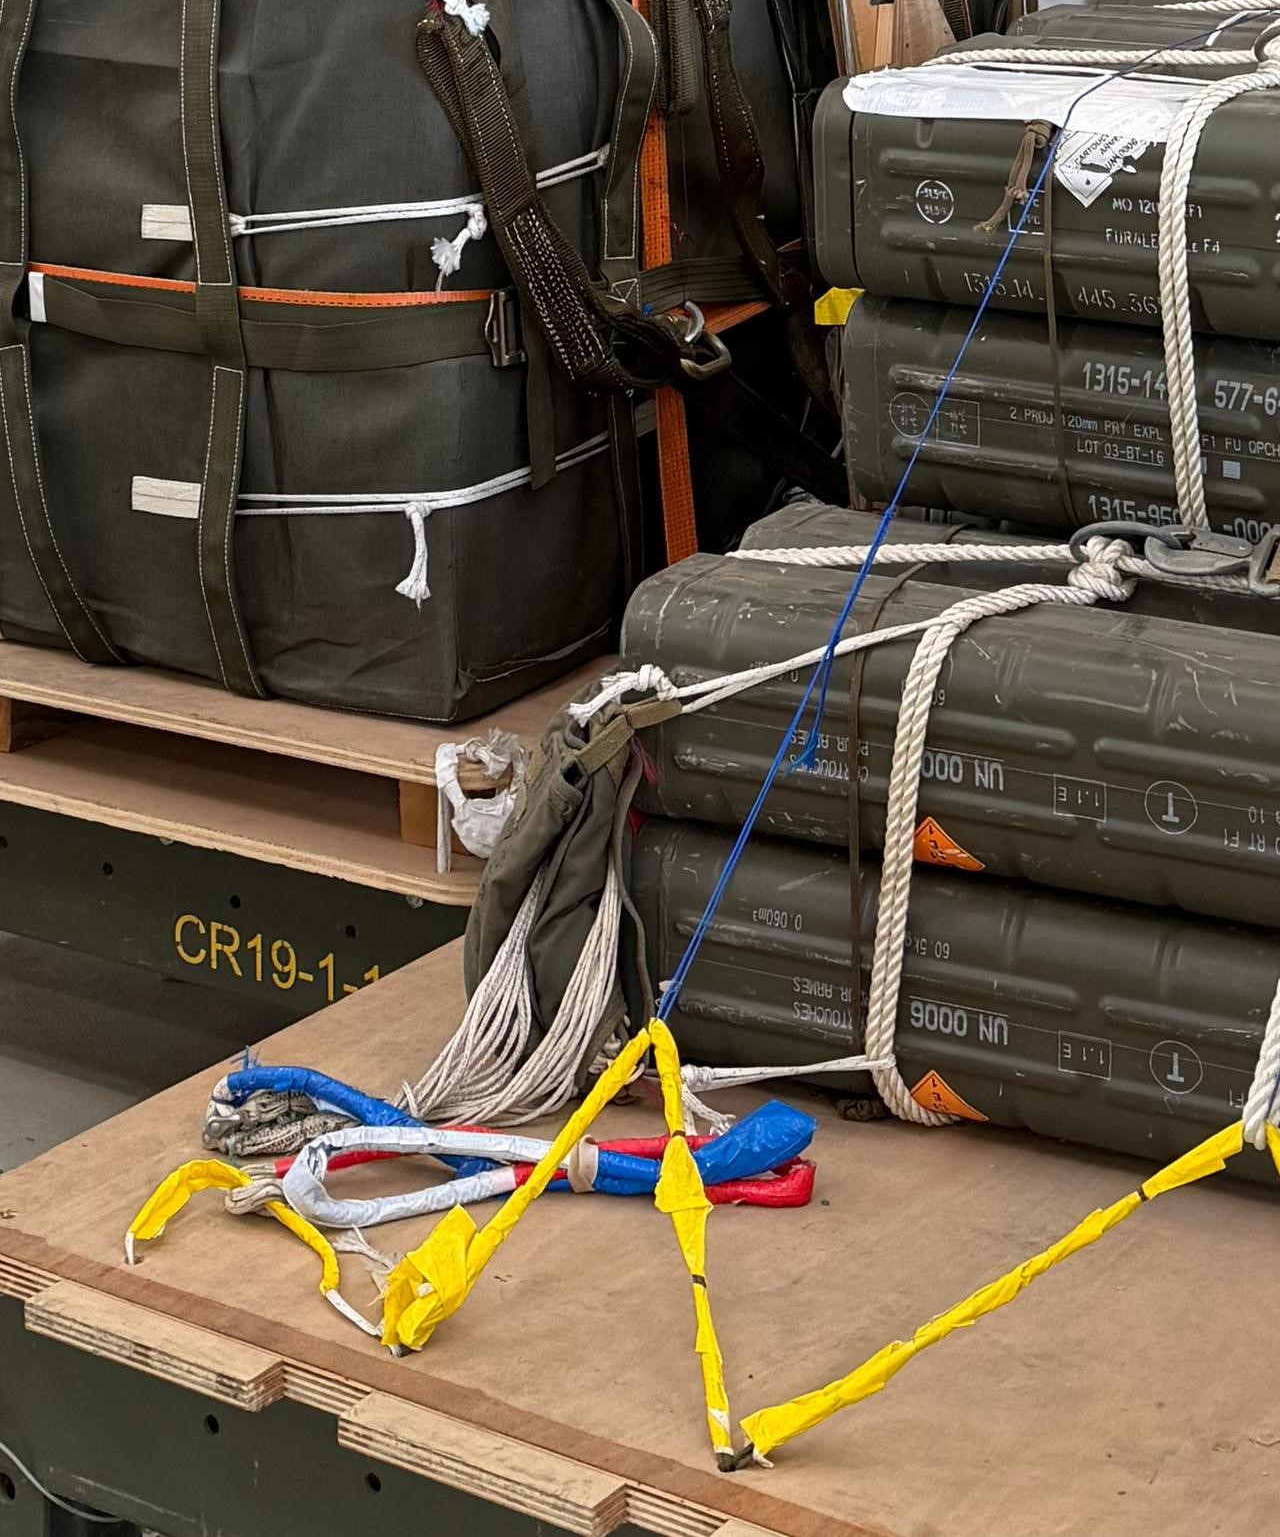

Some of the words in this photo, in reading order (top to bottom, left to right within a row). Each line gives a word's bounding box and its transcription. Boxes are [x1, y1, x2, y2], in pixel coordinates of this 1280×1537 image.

[1009, 406, 1018, 420] 2
[1104, 417, 1127, 435] PRY
[1133, 424, 1164, 441] EXPL
[1224, 438, 1241, 452] FU
[1077, 438, 1099, 455] LOT
[1104, 442, 1165, 465] 03-BT-16
[974, 760, 1005, 791] UN
[1161, 792, 1180, 823] T
[1223, 828, 1241, 848] F1
[1248, 832, 1266, 853] RT
[792, 976, 833, 999] ARMES
[910, 1000, 968, 1038] 0006
[978, 1013, 1009, 1046] UN
[1166, 1052, 1185, 1083] T
